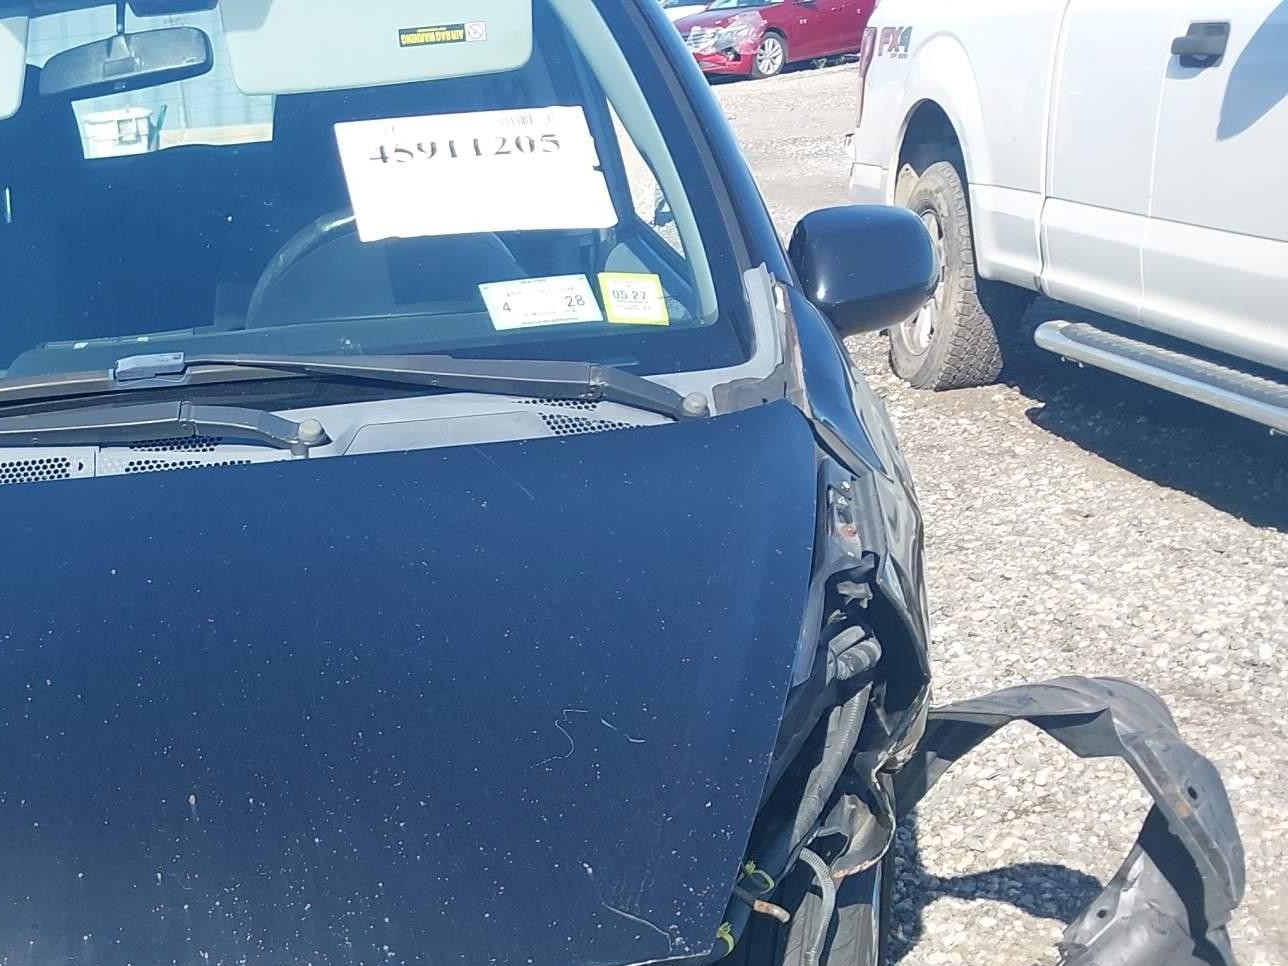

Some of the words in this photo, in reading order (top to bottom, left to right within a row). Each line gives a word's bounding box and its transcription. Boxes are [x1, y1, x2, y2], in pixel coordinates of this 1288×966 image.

[878, 26, 913, 57] FX4
[369, 133, 561, 164] 45911205
[502, 302, 512, 312] 4
[564, 294, 586, 308] 28
